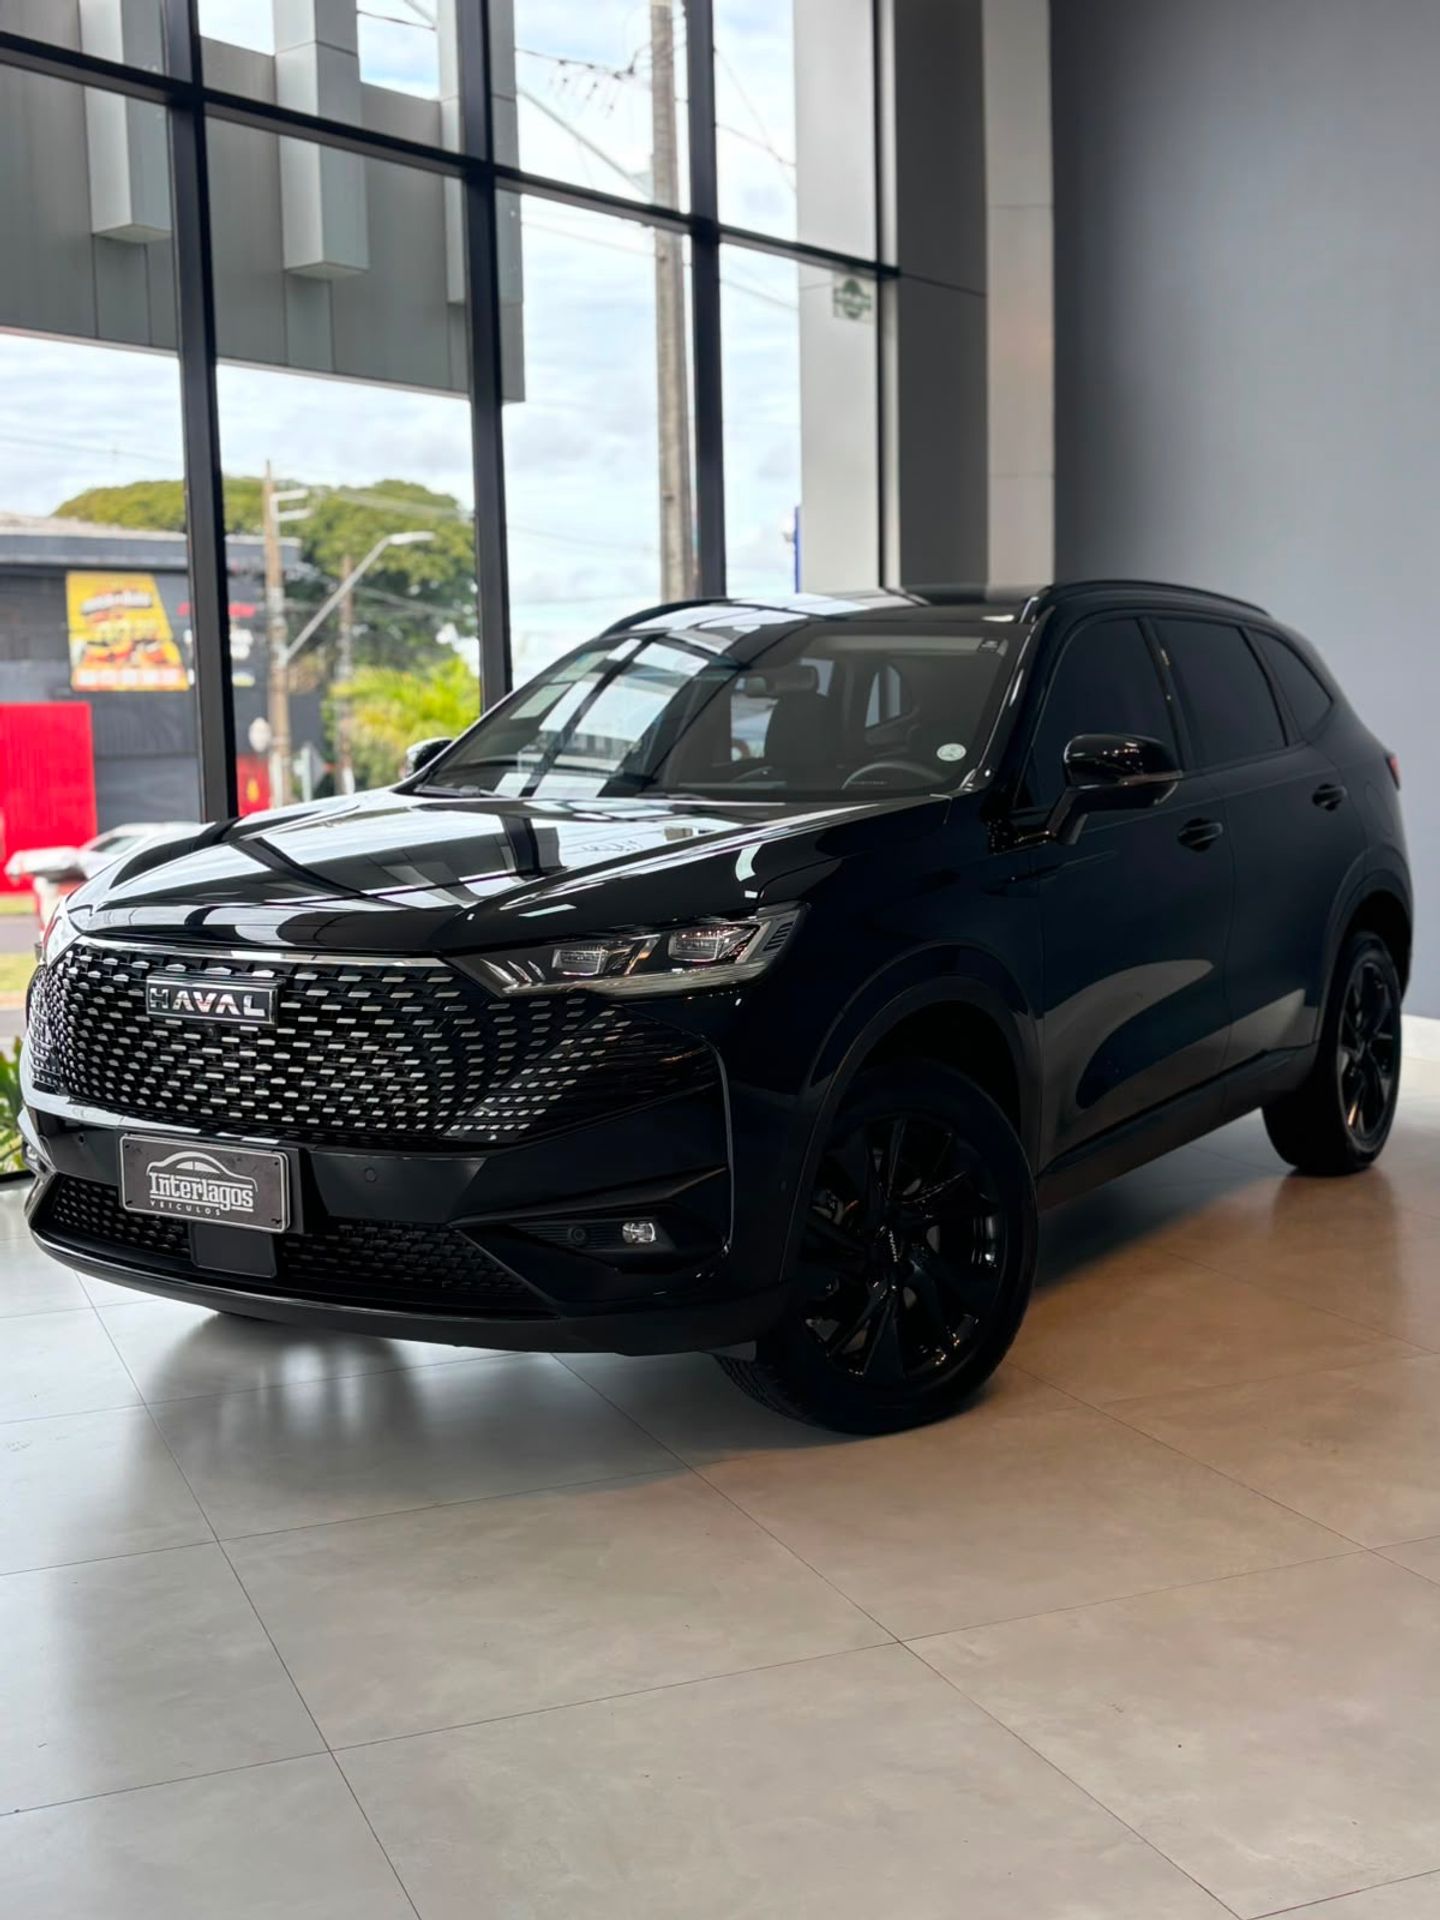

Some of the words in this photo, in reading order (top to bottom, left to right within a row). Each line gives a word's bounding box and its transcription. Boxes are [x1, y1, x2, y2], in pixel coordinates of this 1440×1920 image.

[149, 986, 265, 1017] HAVAL
[148, 1172, 253, 1211] Interlagos
[150, 1200, 221, 1216] VEICULOS
